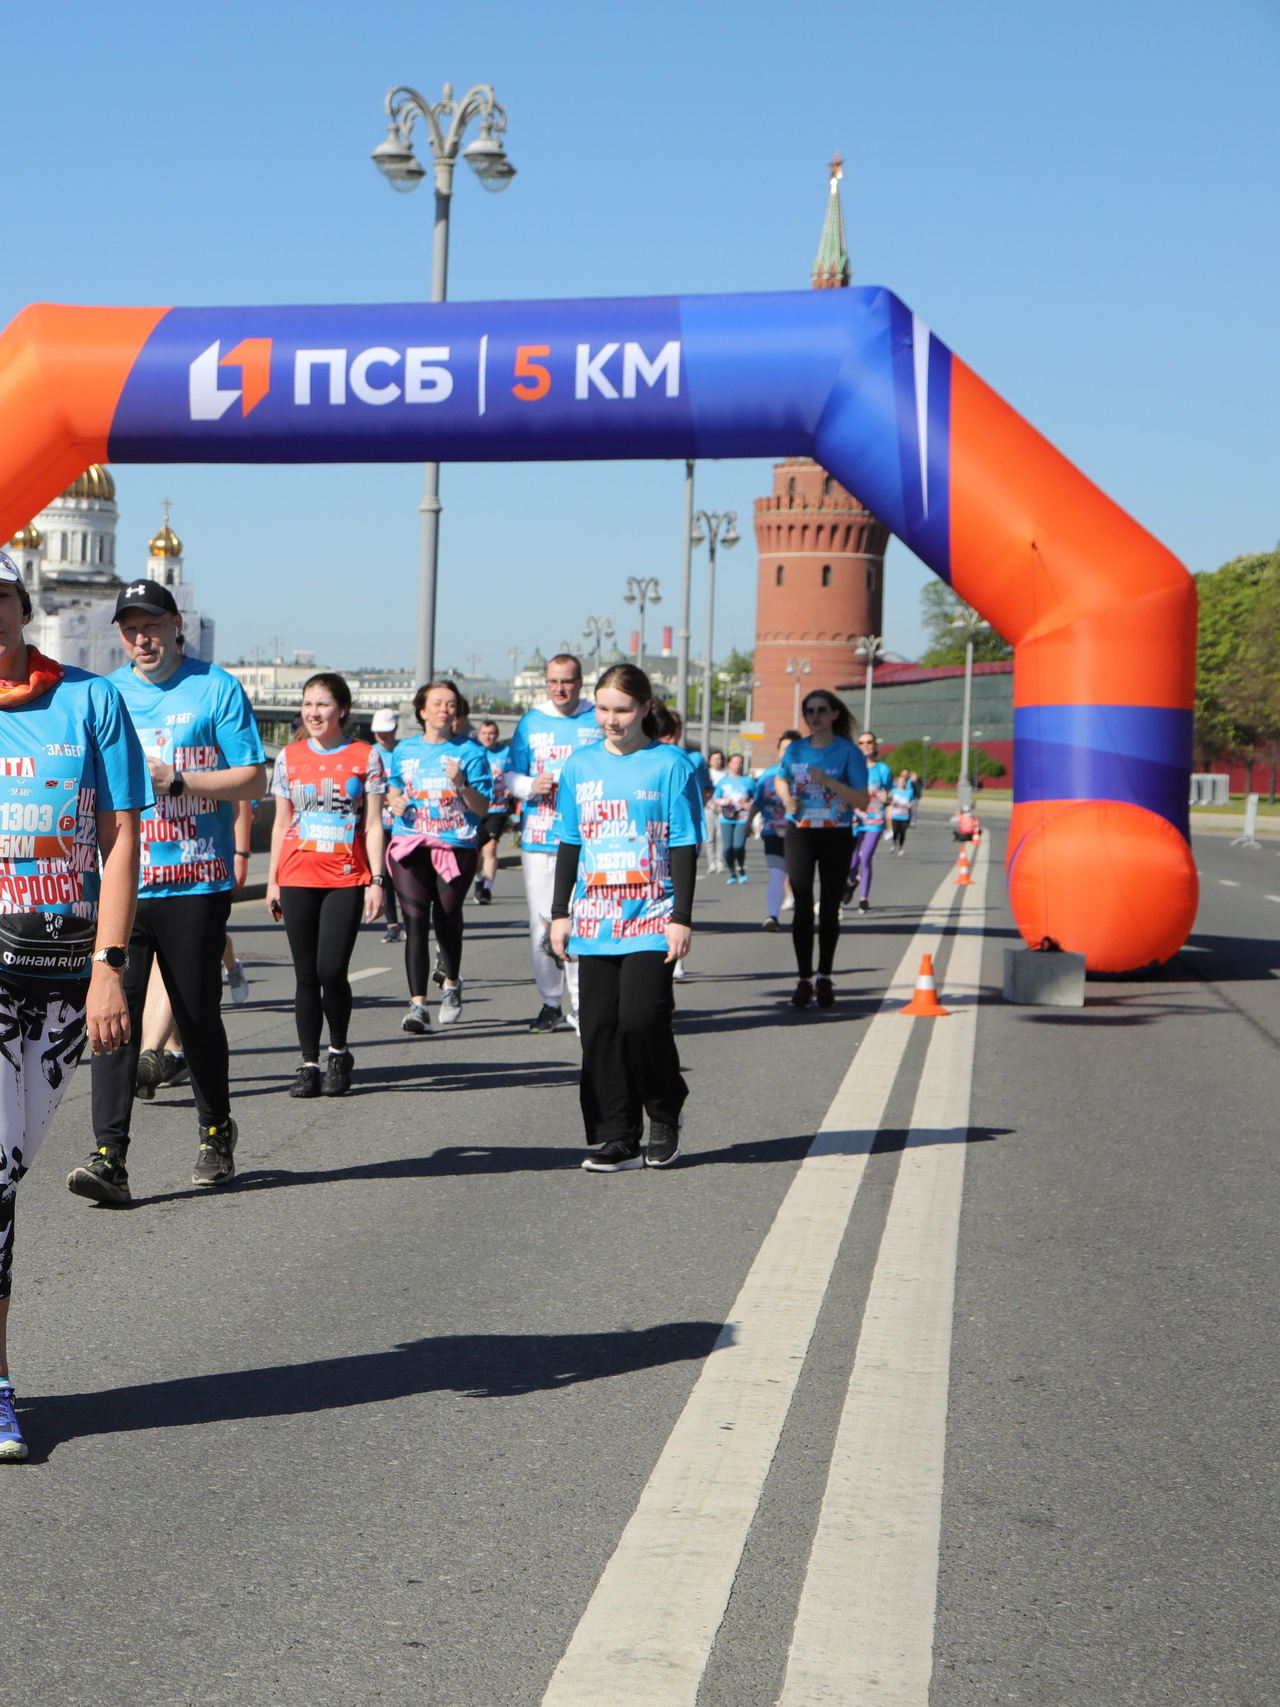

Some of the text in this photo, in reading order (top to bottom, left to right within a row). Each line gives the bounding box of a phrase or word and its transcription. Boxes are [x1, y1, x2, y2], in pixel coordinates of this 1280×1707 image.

[294, 341, 681, 405] ПСБ 5 КМ
[576, 780, 603, 805] 2024
[180, 837, 216, 864] 2024
[596, 851, 637, 870] 25370
[141, 858, 231, 888] #ЕДИНСТВО
